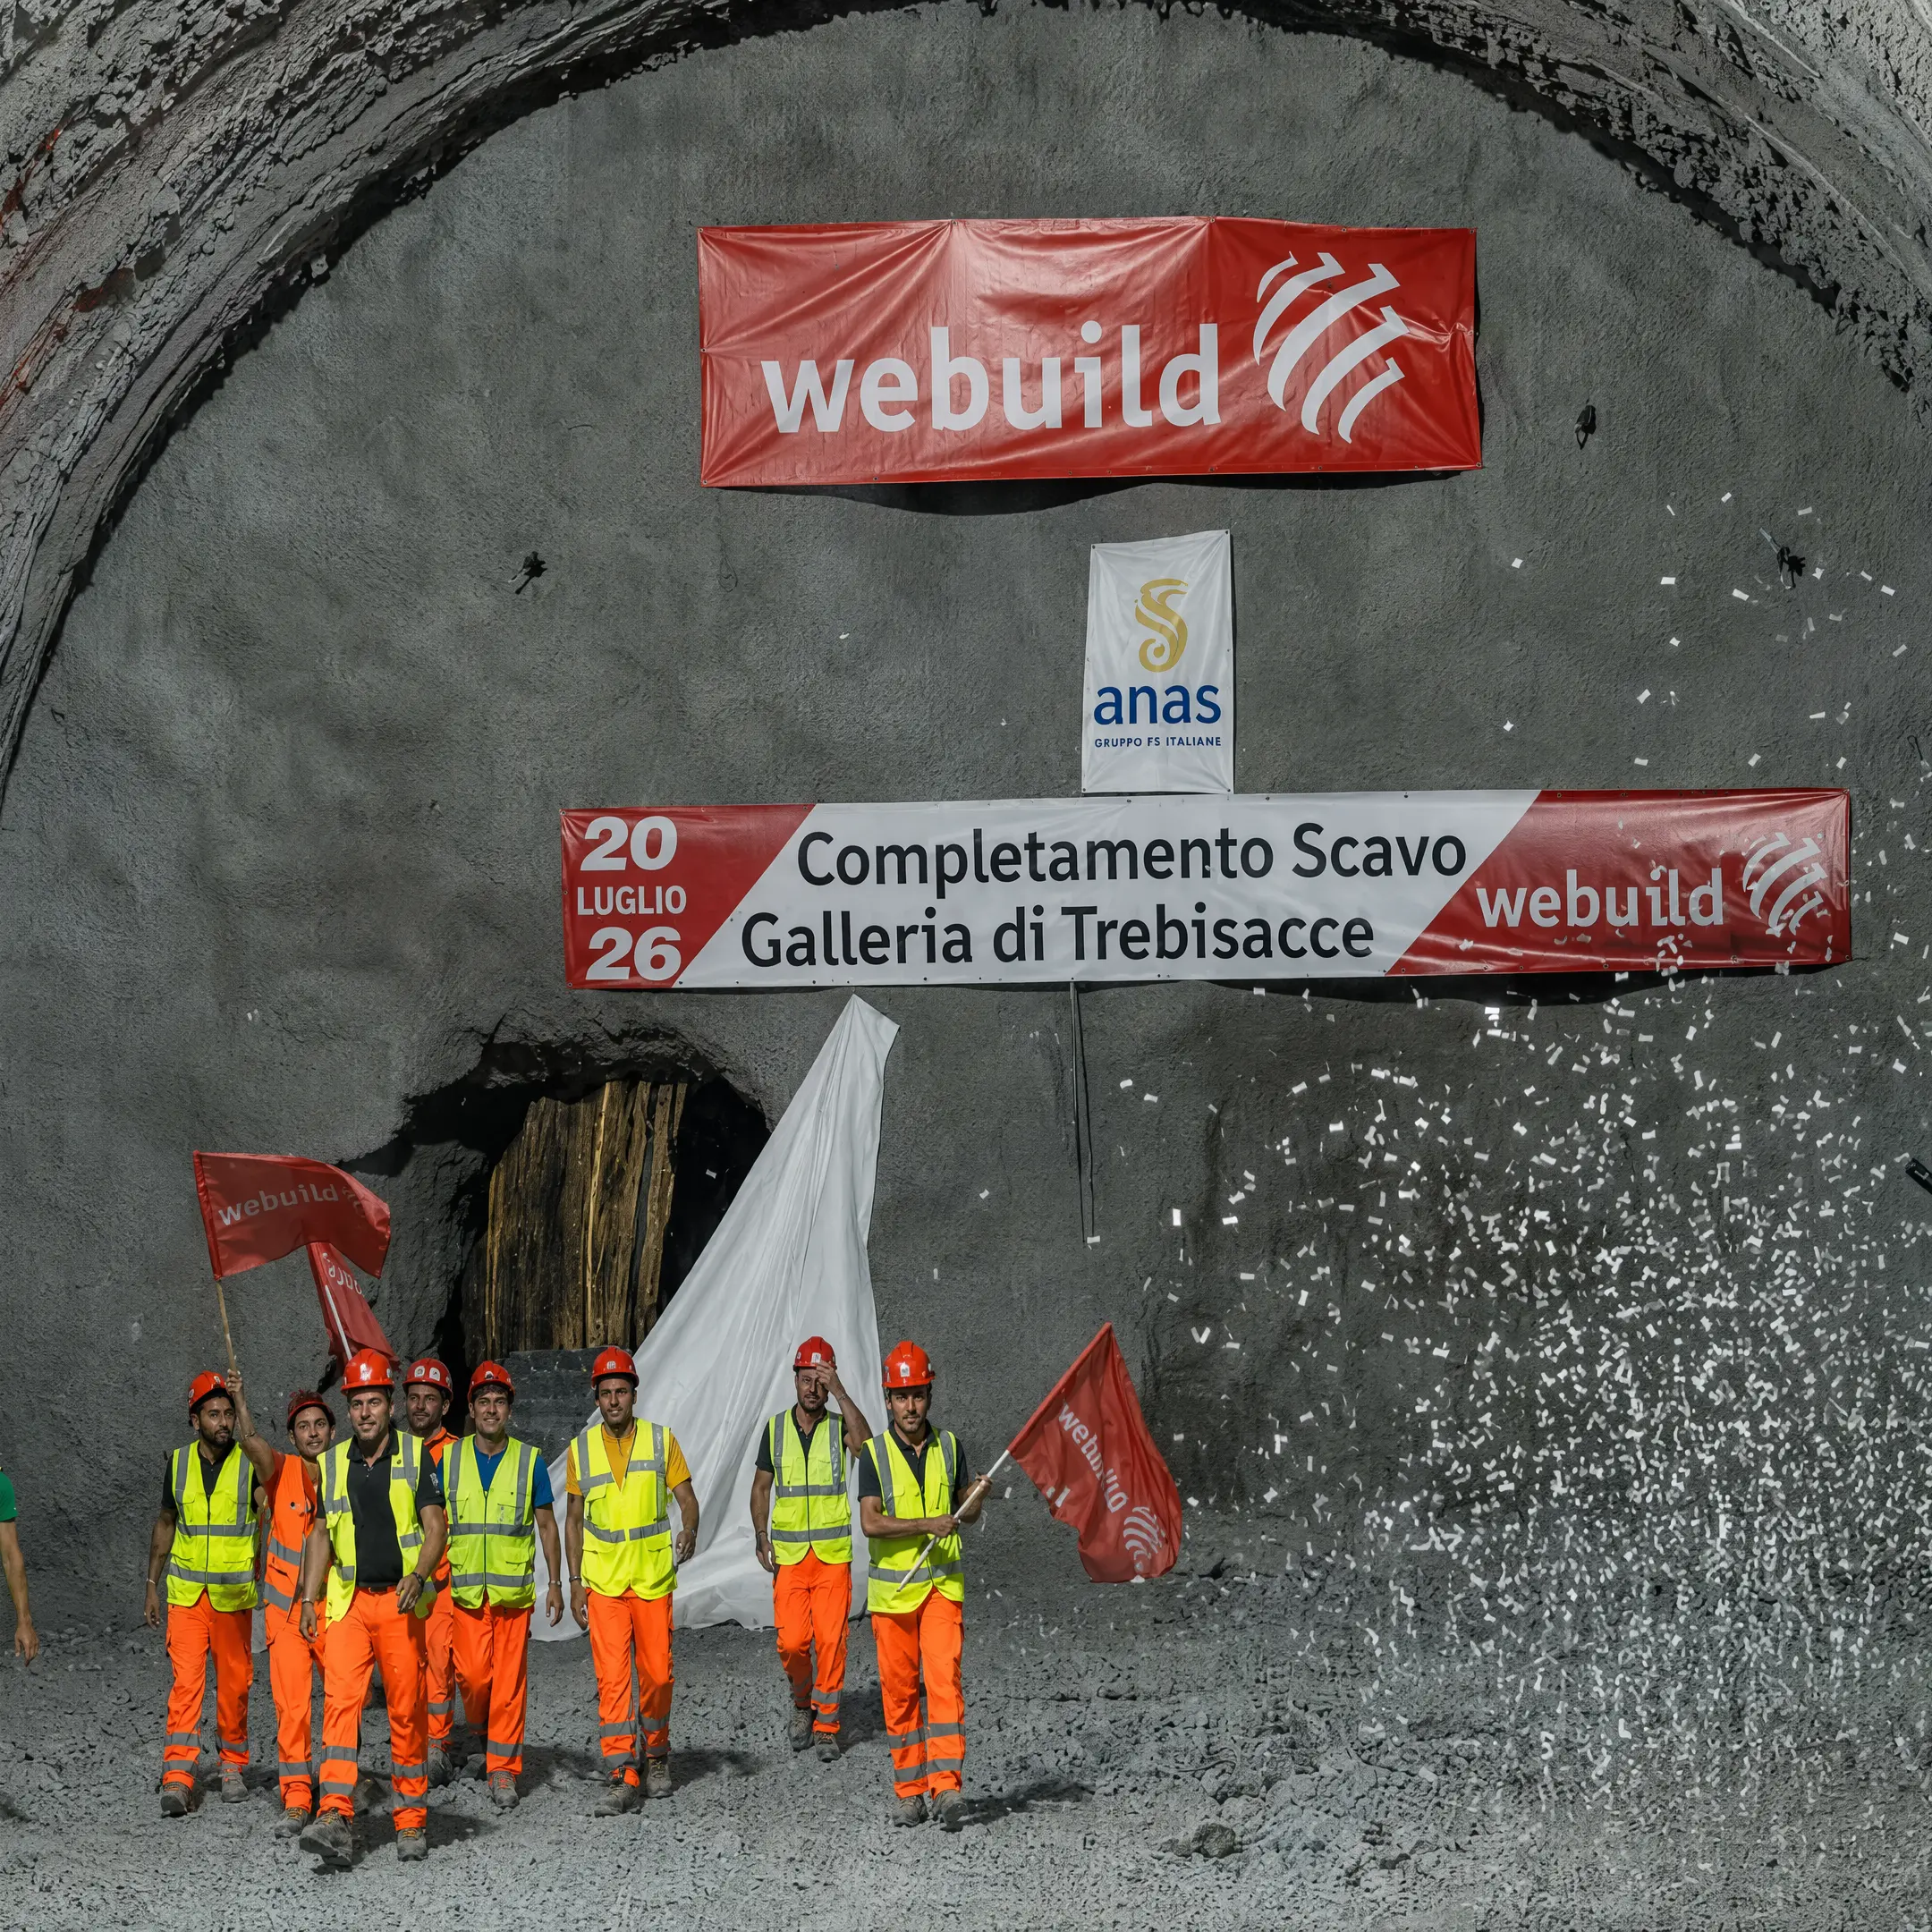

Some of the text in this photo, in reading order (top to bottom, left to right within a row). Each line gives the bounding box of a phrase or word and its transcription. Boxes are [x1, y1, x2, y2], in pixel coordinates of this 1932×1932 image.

[761, 321, 1221, 434] webuild
[1093, 684, 1221, 725] anas
[1094, 736, 1222, 748] GRUPPO FS ITALIANE
[580, 816, 678, 872] 20
[798, 822, 1467, 900] Completamento Scavo
[577, 885, 687, 916] LUGLIO
[1476, 866, 1724, 928] webuild
[586, 926, 682, 981] 26
[741, 902, 1374, 968] Galleria di Trebisacce
[218, 1183, 339, 1226] webuild
